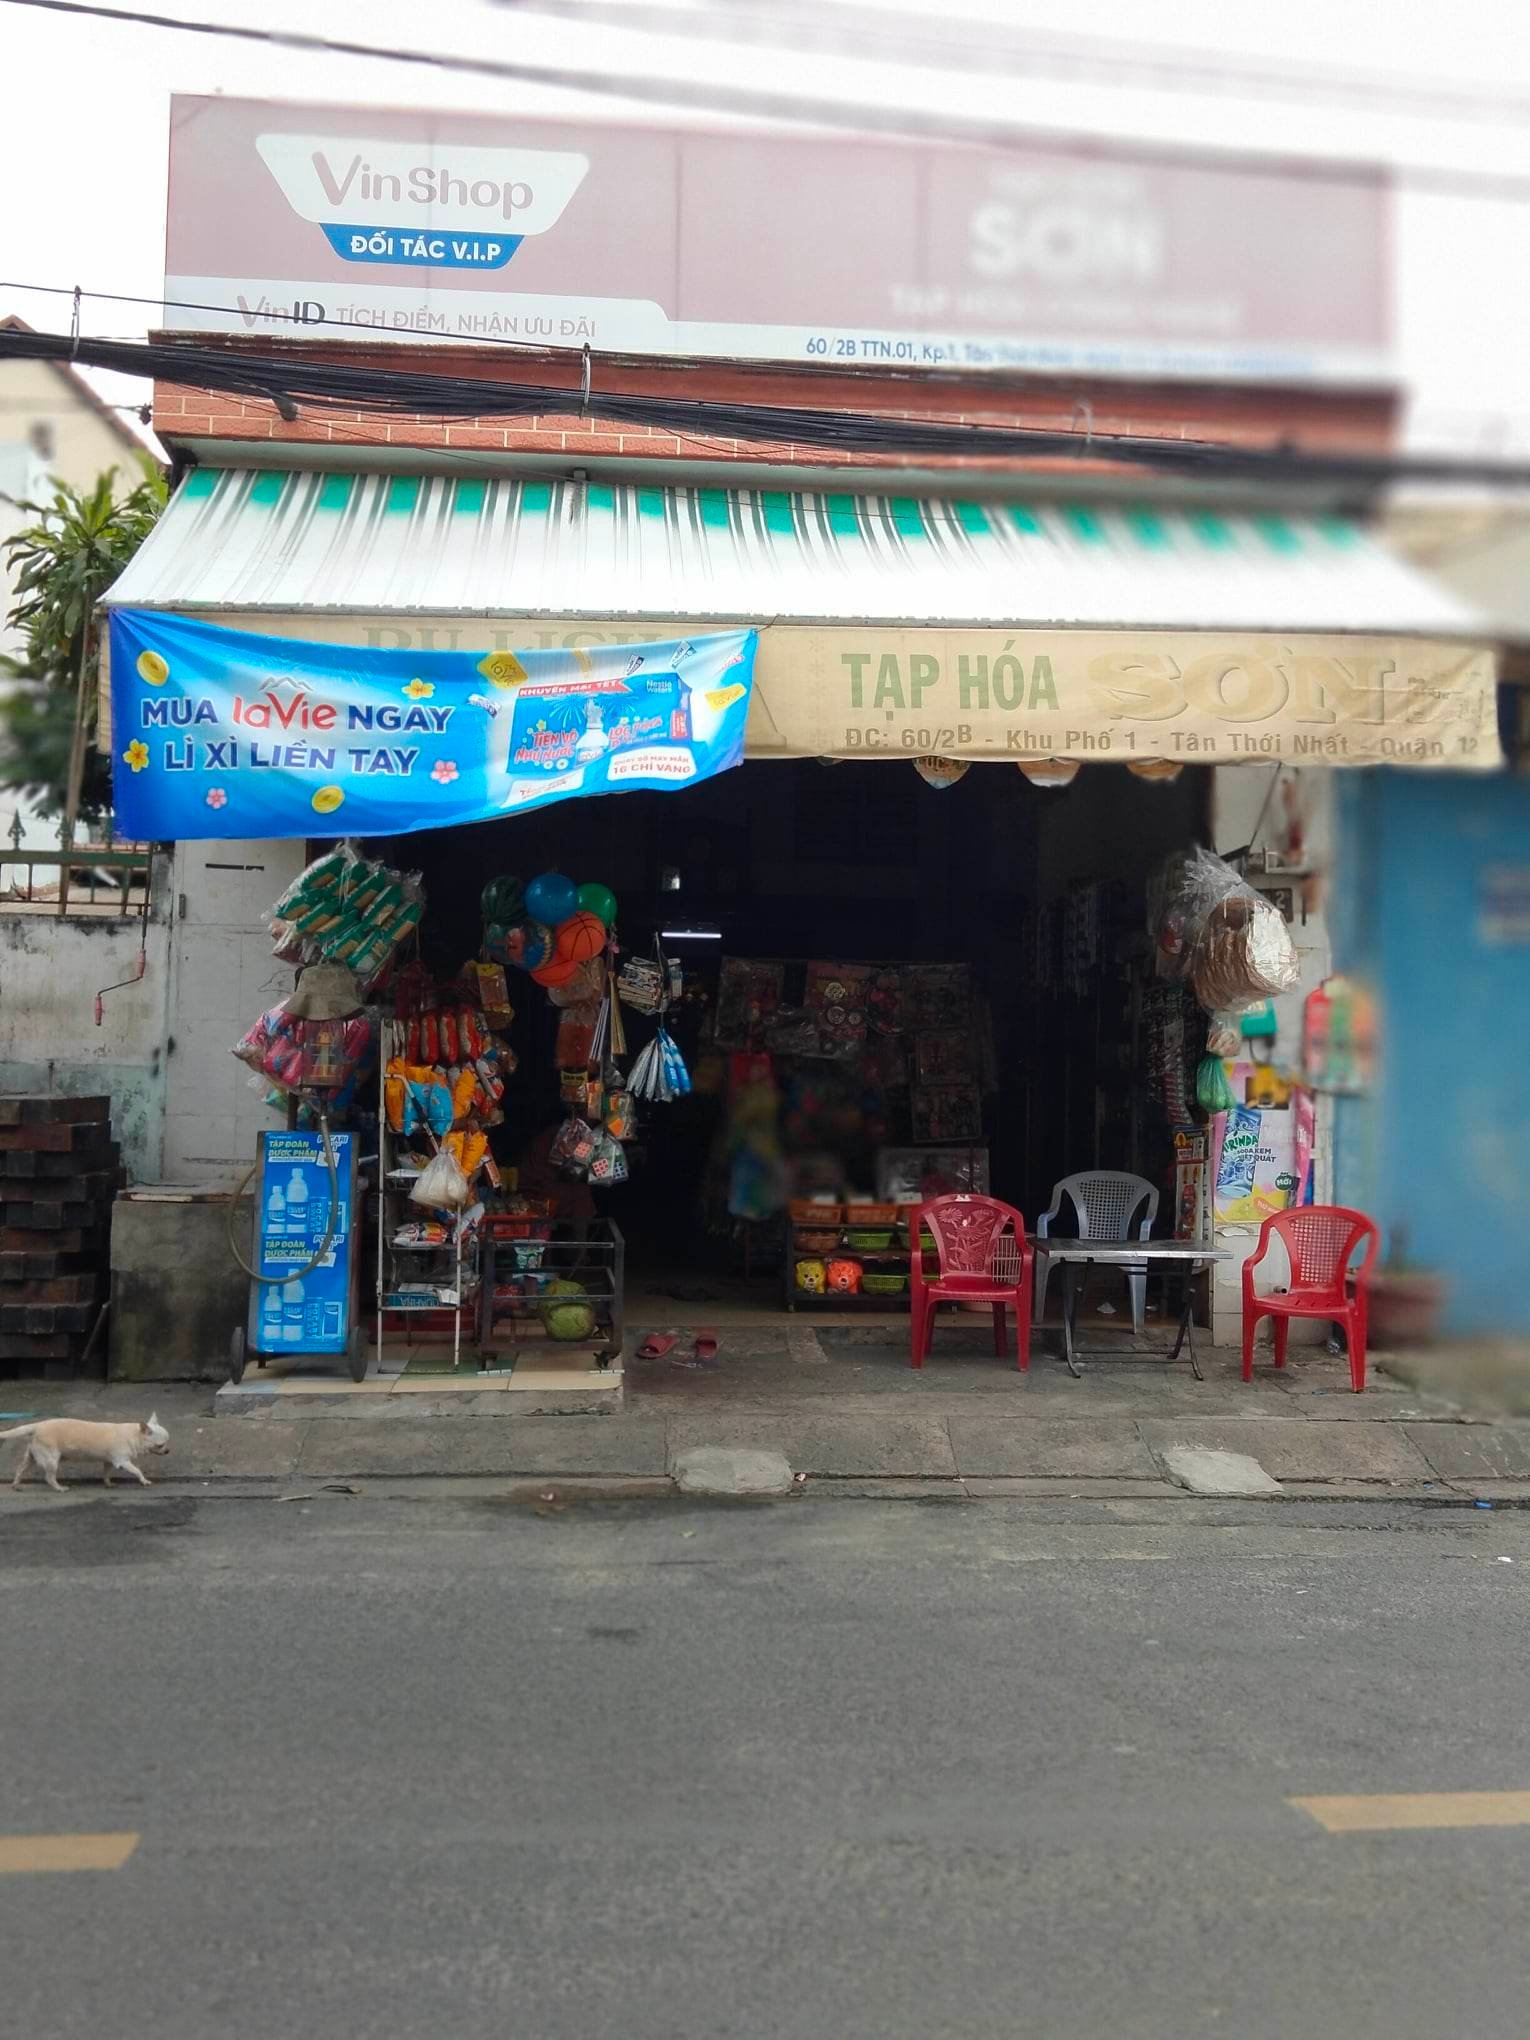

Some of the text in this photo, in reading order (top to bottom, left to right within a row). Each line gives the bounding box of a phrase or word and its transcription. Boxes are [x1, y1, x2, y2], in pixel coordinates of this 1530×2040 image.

[311, 151, 534, 220] VinShop
[350, 230, 501, 262] ĐỐI TÁC V.I.P
[237, 295, 596, 339] VinID TÍCH ĐIỂM, NHẬN ƯU ĐÃI
[805, 337, 856, 357] 60/2B
[841, 639, 1060, 721] TẠP HÓA
[142, 691, 452, 732] MUA laVie NGAY
[165, 735, 419, 774] LÌ XÌ LIỀN TAY
[845, 727, 888, 748] ĐC:
[1006, 730, 1052, 750] Khu
[1065, 727, 1115, 750] Phố
[1125, 731, 1135, 751] 1
[1170, 731, 1216, 752] Tân
[1227, 729, 1282, 753] Thới
[1294, 732, 1350, 755] Nhất
[1457, 735, 1478, 755] 12
